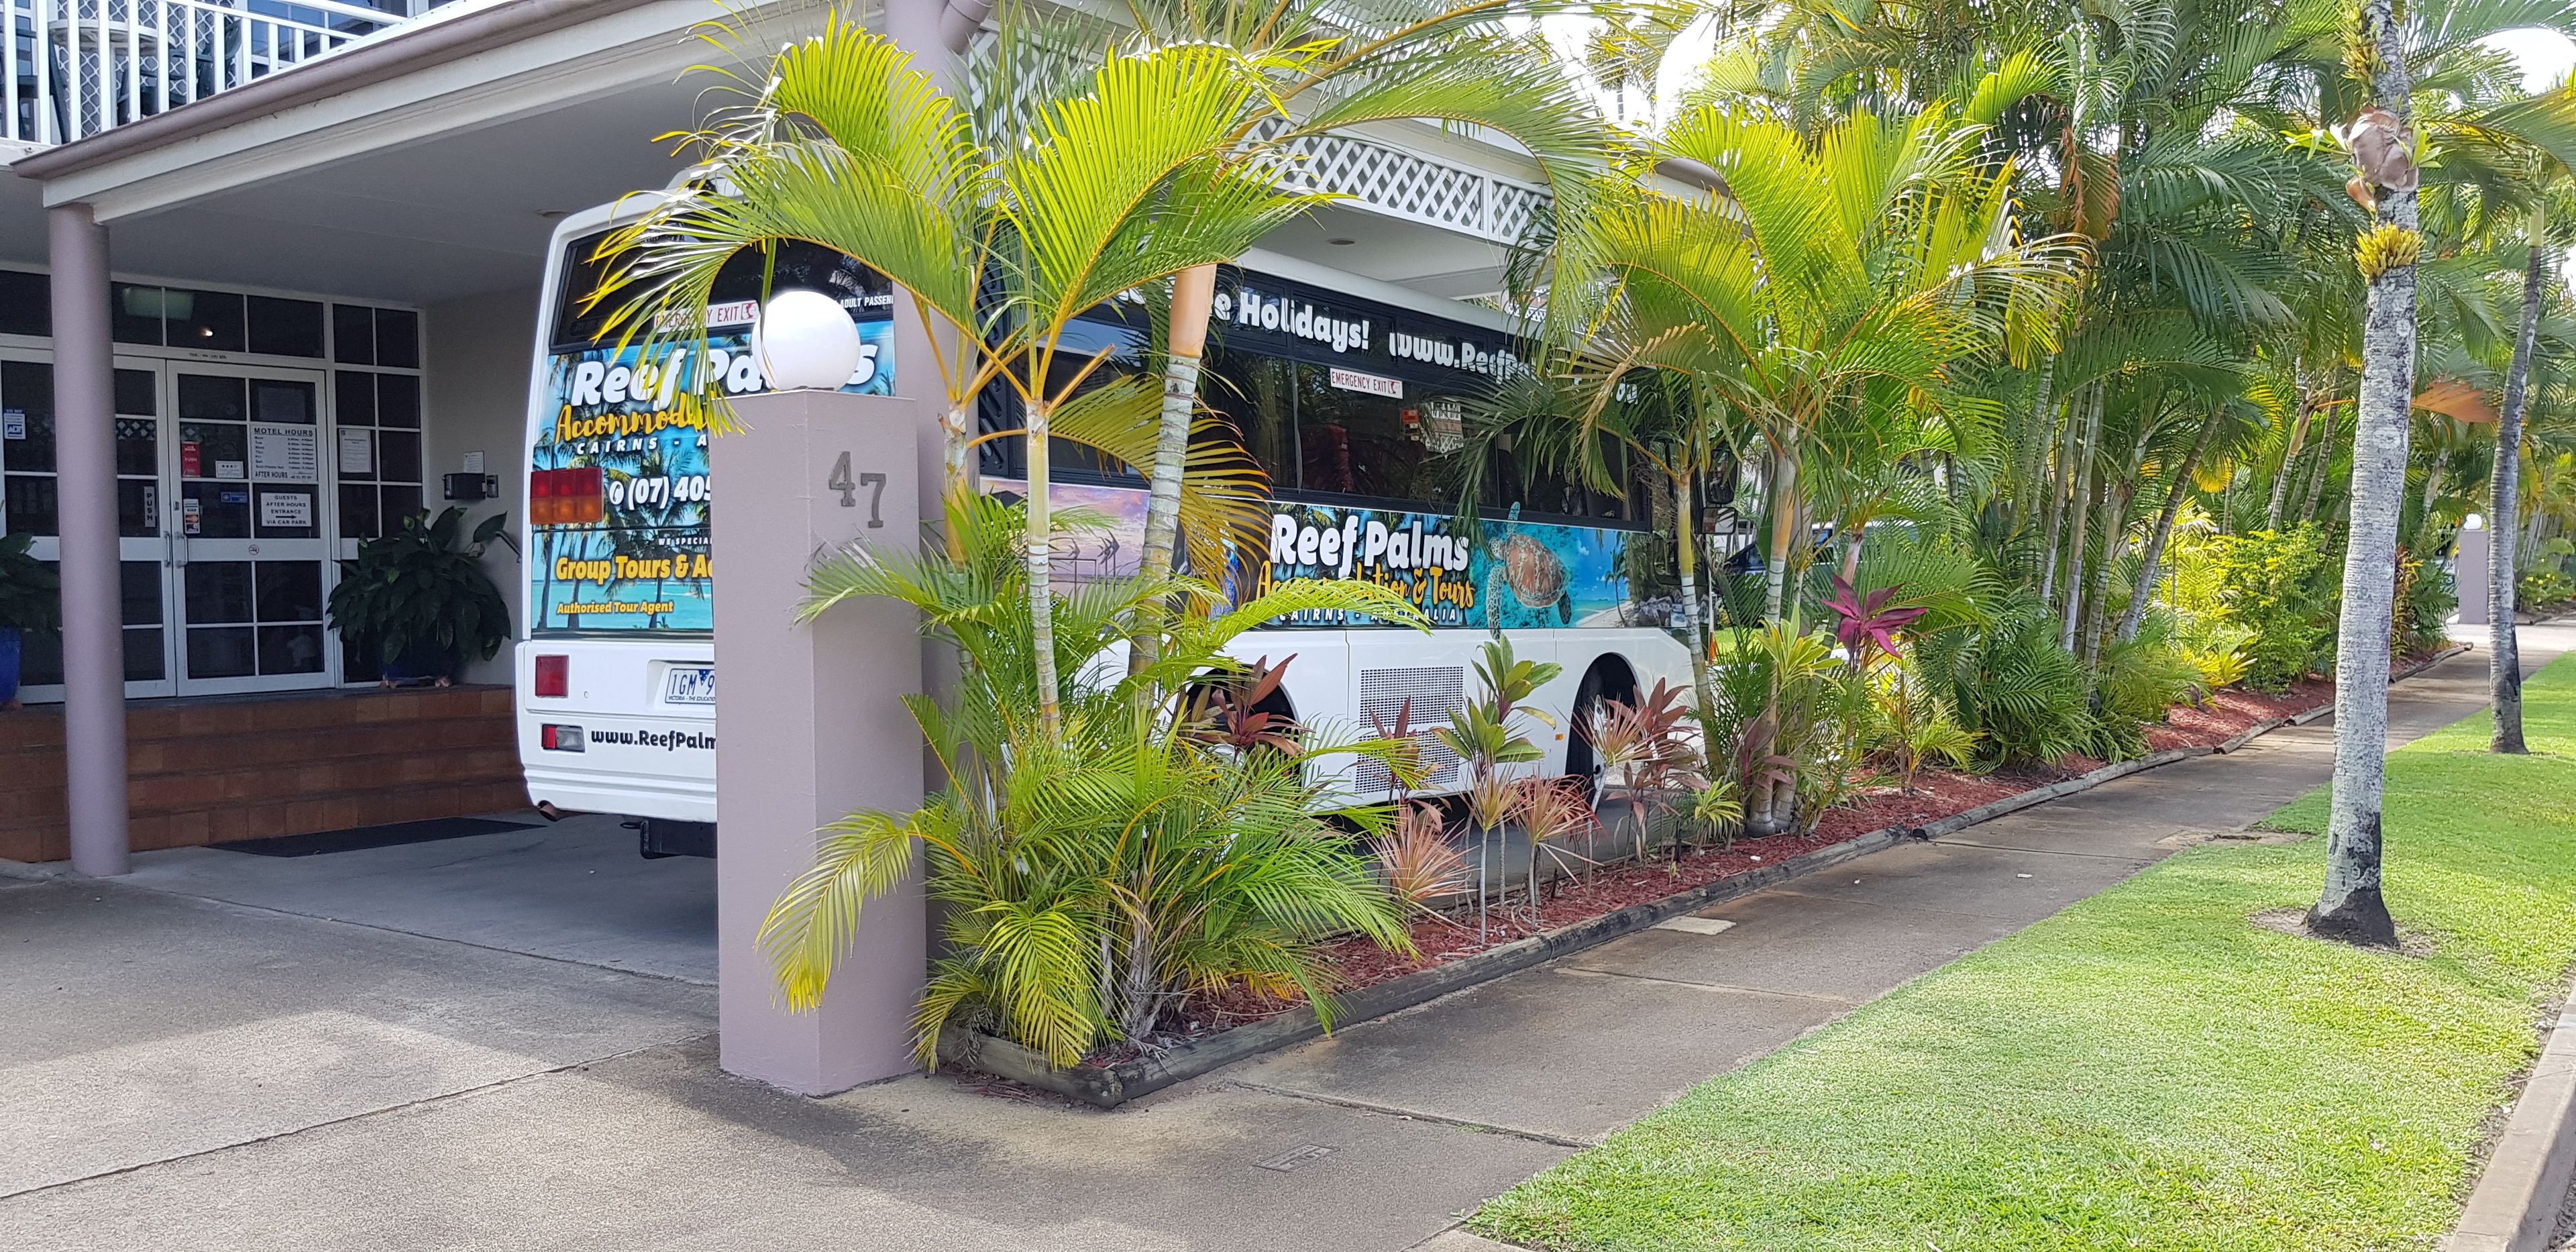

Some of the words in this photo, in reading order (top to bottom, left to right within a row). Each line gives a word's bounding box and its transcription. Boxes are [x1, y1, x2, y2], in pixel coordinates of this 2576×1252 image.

[717, 306, 739, 322] EXIT
[840, 297, 862, 308] ADULT
[1240, 292, 1369, 353] Holidays!
[571, 348, 686, 411] Reef
[694, 345, 878, 396] Pas
[1332, 371, 1370, 390] EMERGENCY
[1373, 379, 1387, 393] EXIT
[555, 392, 708, 444] Accommod
[577, 437, 657, 454] CAIRNS
[628, 476, 669, 510] (07)
[828, 451, 886, 529] 47
[1270, 515, 1358, 578] Reef
[1364, 521, 1469, 572] Palms
[555, 557, 611, 584] Group
[614, 556, 671, 578] Tours
[675, 554, 688, 578] &
[1412, 569, 1427, 604] &
[1429, 566, 1475, 609] Tours
[557, 602, 612, 614] Authorised
[614, 601, 638, 613] Tour
[640, 601, 674, 615] Agent
[672, 674, 697, 695] 1GM
